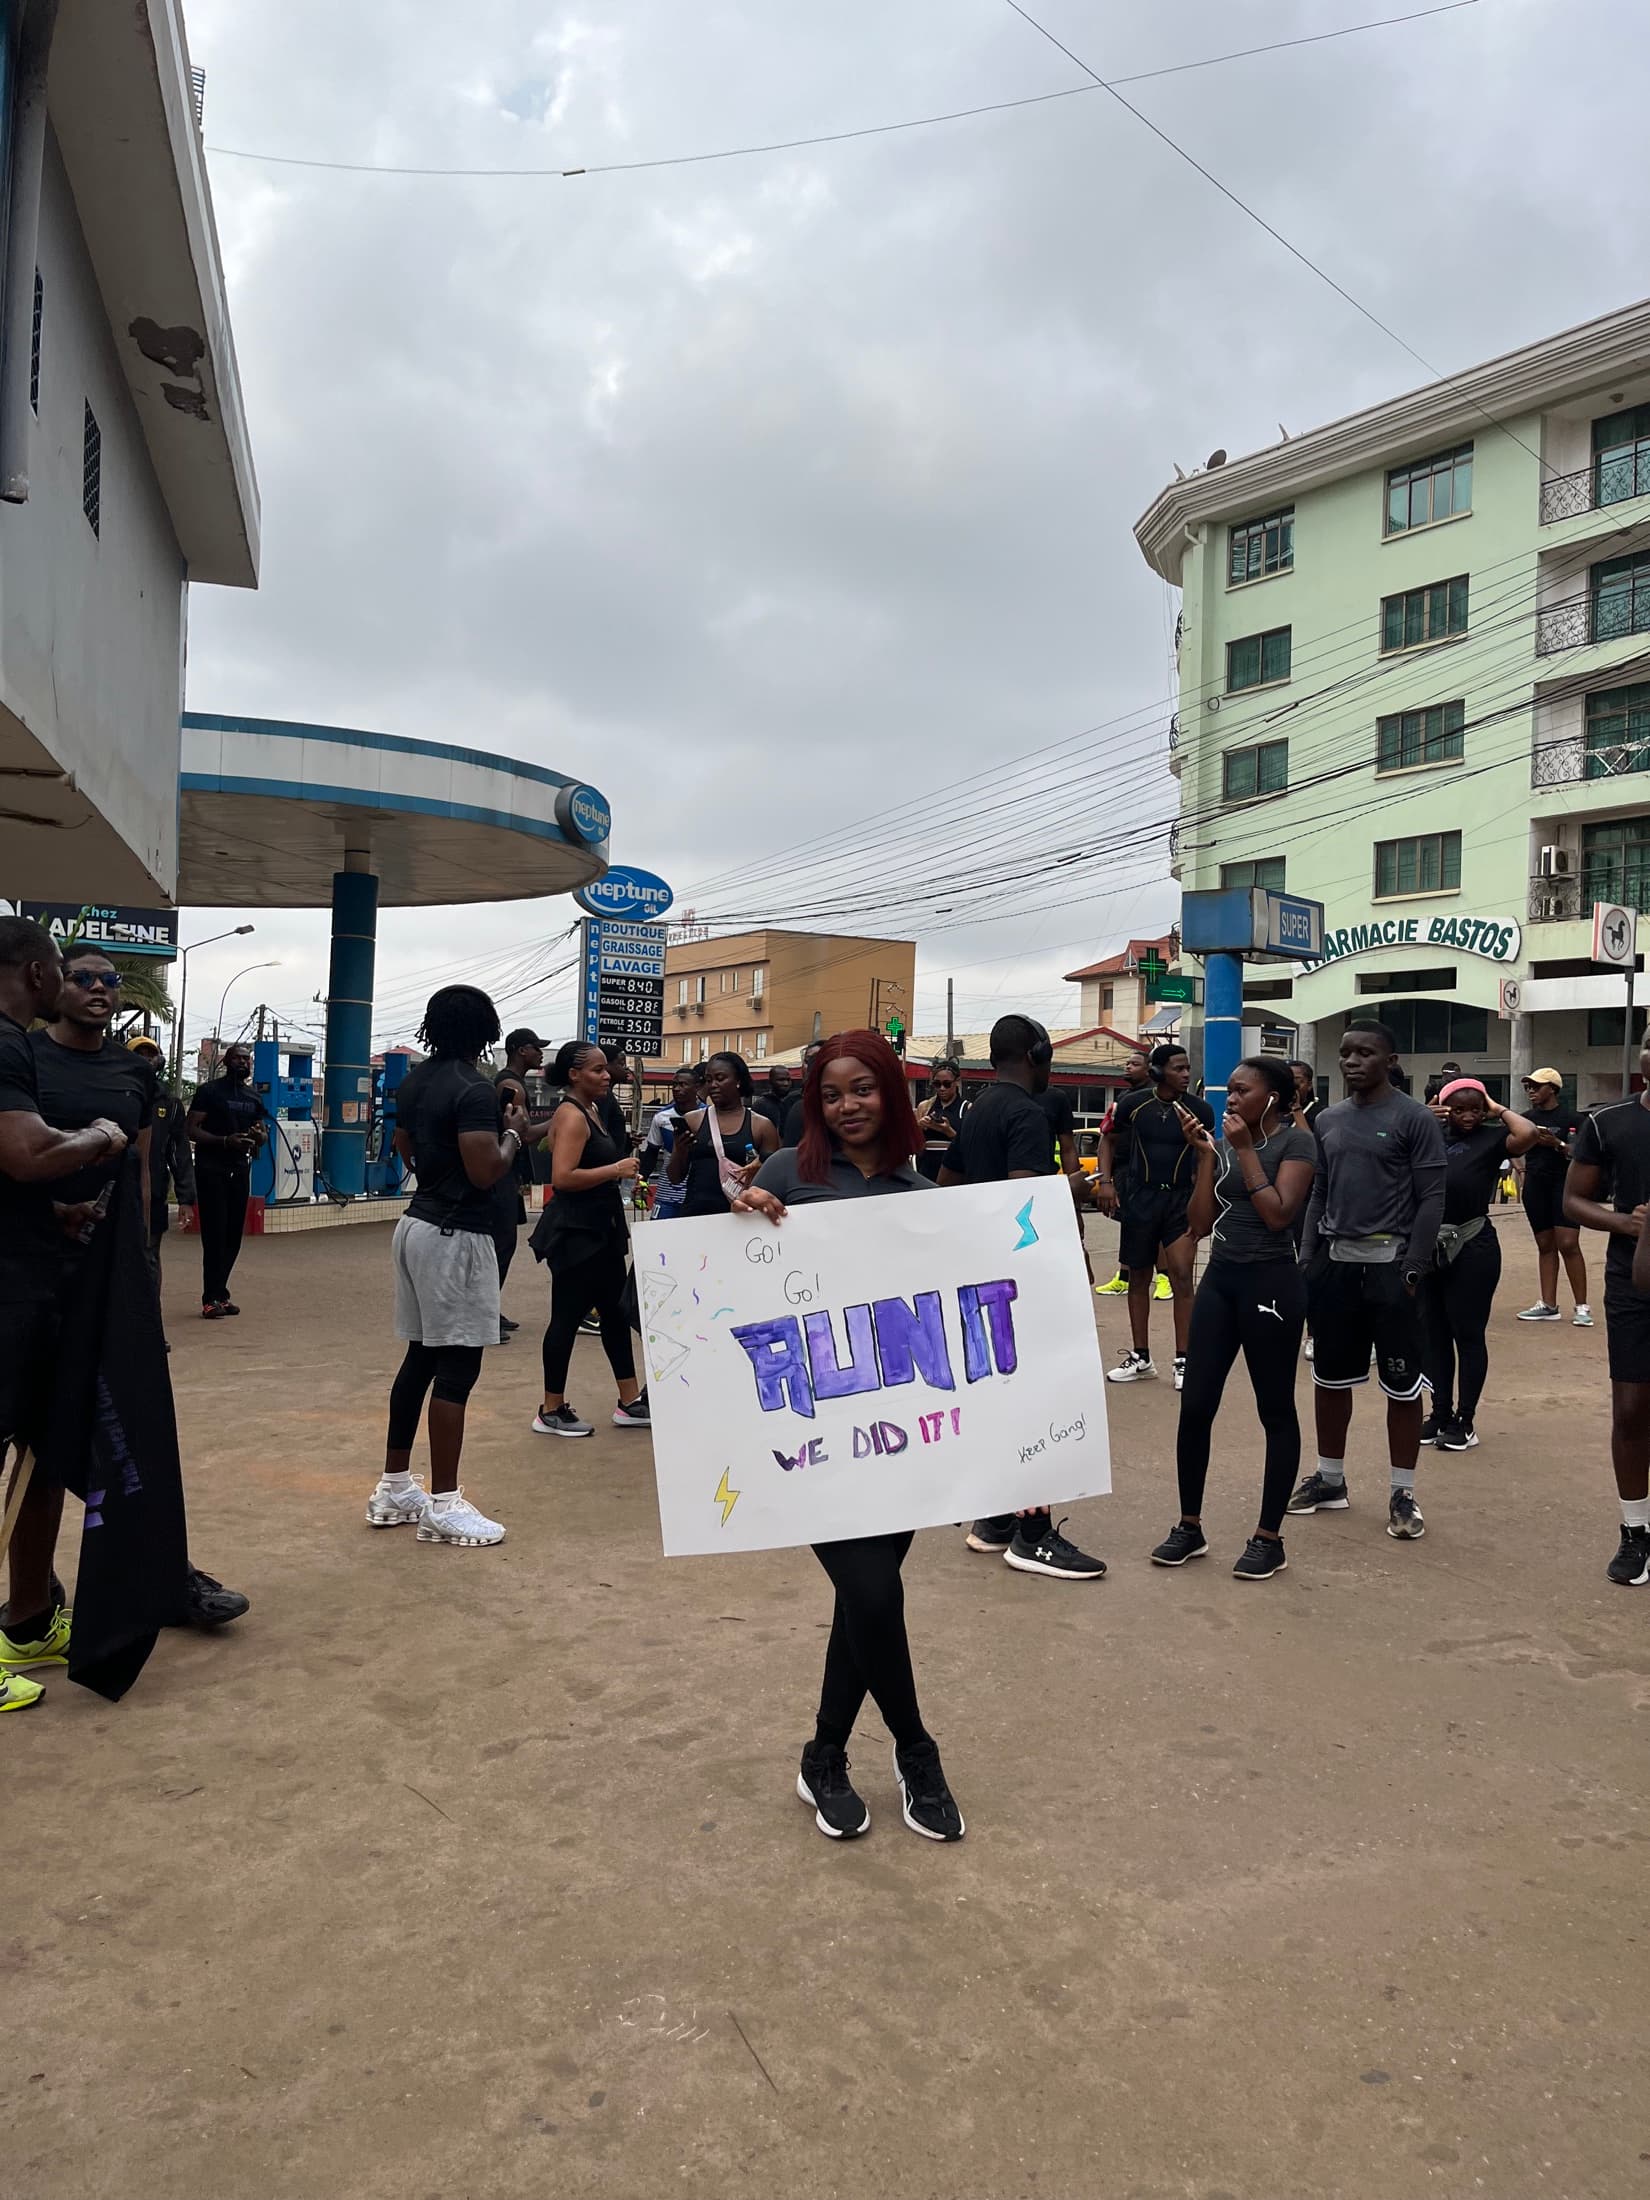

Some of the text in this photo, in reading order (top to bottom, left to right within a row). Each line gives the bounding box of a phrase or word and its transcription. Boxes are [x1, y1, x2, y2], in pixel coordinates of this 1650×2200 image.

[574, 799, 609, 826] neptune
[589, 881, 669, 902] neptune
[643, 903, 659, 914] OIL
[26, 915, 170, 945] ADELEINE
[603, 922, 665, 940] BOUTIQUE
[1281, 912, 1309, 940] SUPER
[1427, 917, 1513, 959] BASTOS
[602, 940, 663, 957] GRAISSAGE
[603, 958, 661, 975] LAVAGE
[601, 977, 626, 986] SUPER
[600, 997, 626, 1006] GASOIL
[599, 1037, 617, 1046] GAZ
[956, 1278, 1018, 1385] IT
[771, 1437, 829, 1471] WE
[853, 1421, 909, 1458] DID
